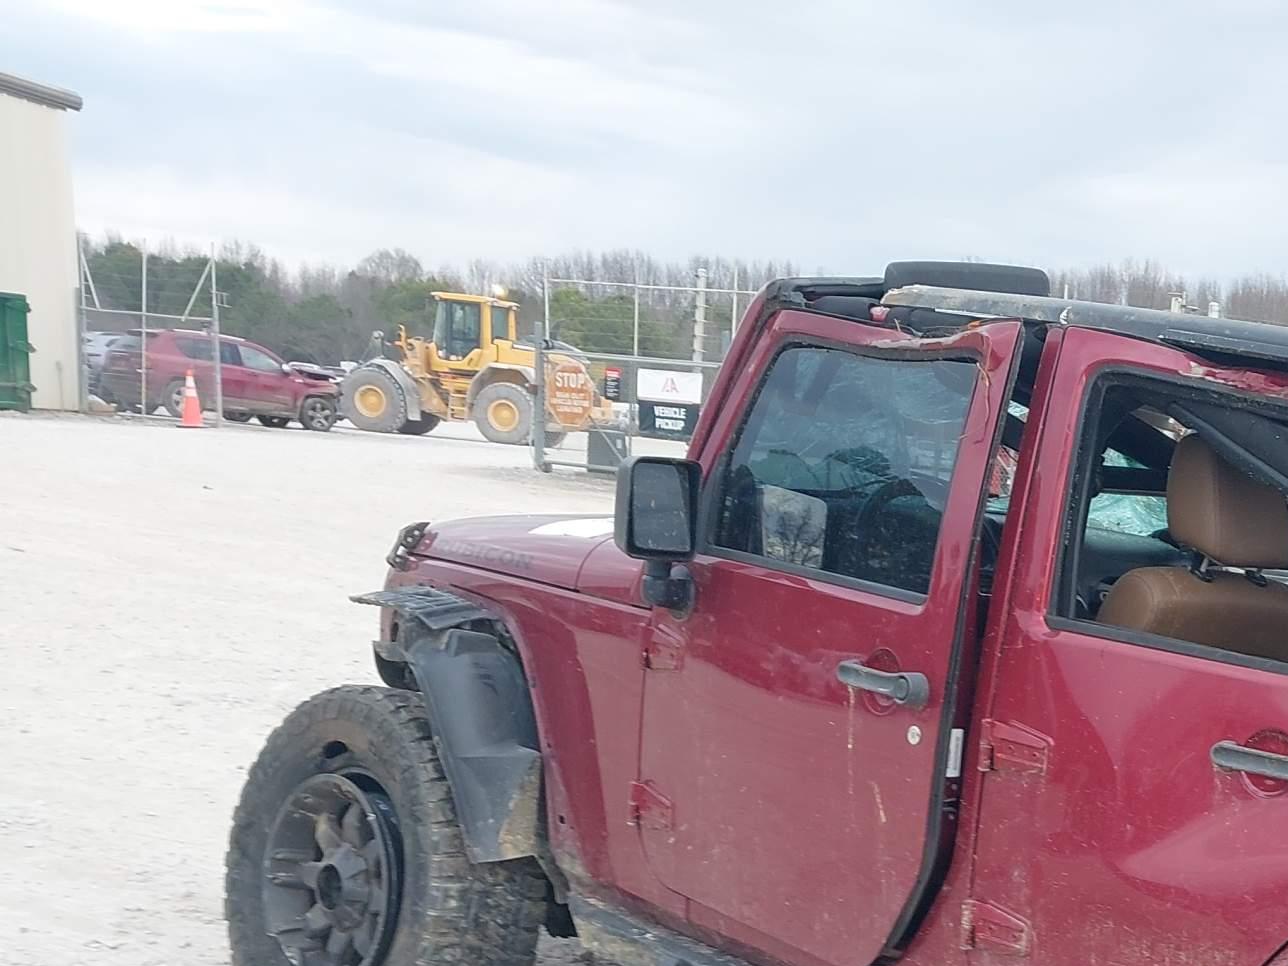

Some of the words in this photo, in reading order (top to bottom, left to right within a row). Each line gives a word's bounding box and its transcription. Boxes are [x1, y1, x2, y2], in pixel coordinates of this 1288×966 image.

[555, 371, 585, 388] STOP
[653, 405, 687, 419] VEHICLE
[655, 418, 685, 431] PICKUP
